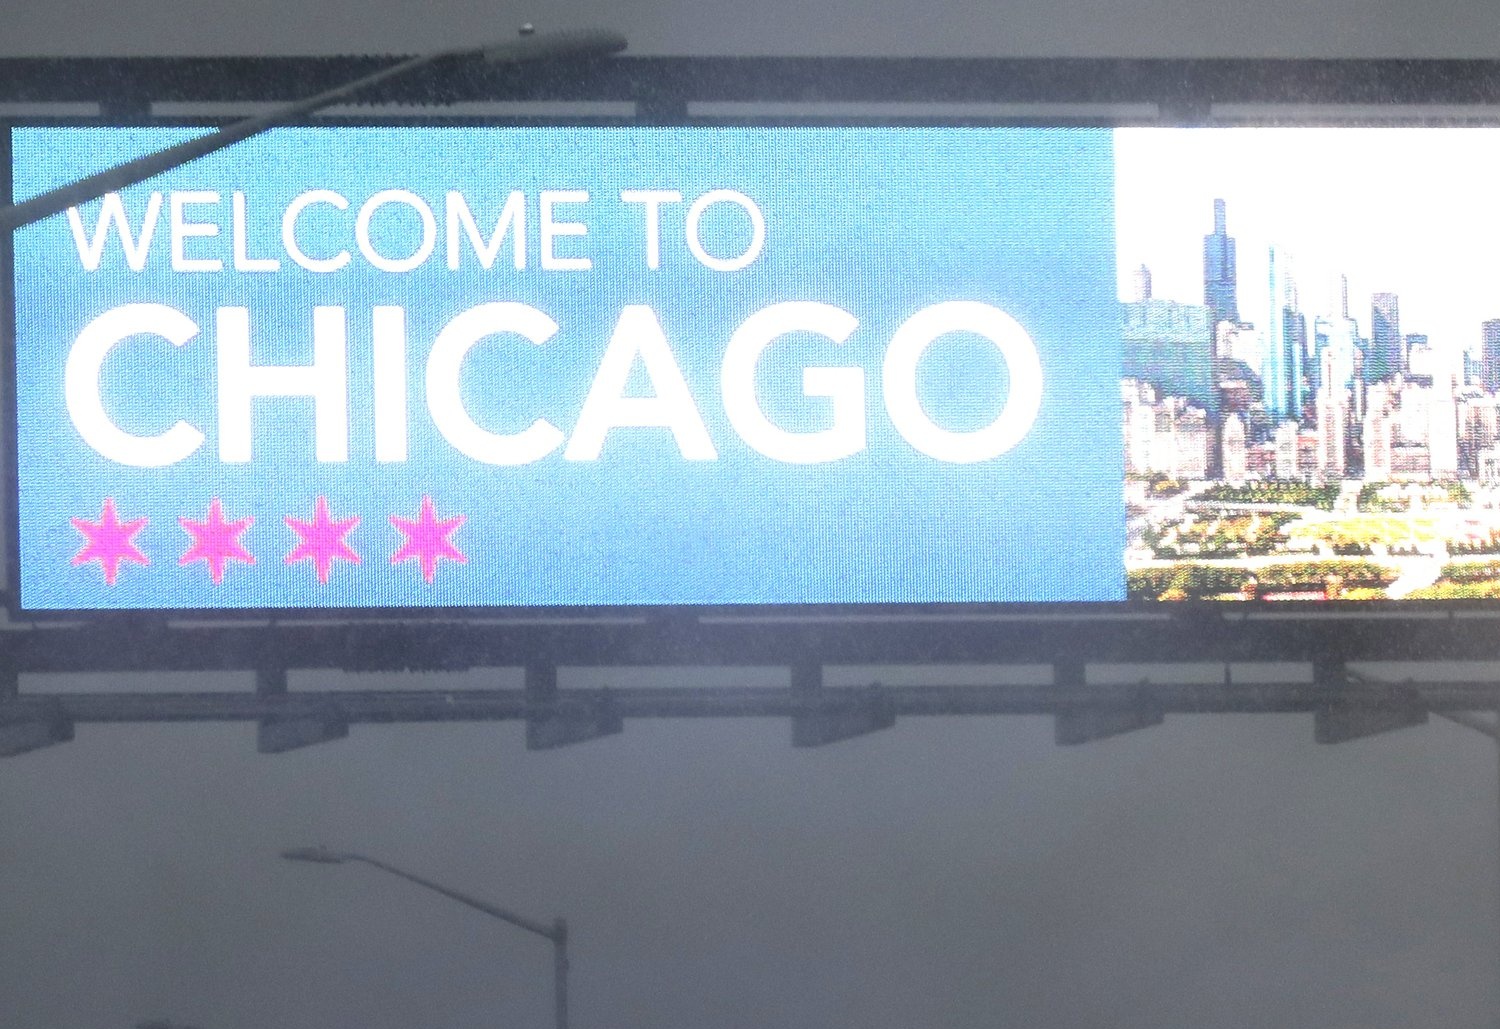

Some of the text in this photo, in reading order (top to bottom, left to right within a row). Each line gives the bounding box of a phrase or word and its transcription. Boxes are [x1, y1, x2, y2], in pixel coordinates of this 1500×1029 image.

[67, 188, 767, 273] WELCOME TO
[63, 299, 1046, 469] CHICAGO
